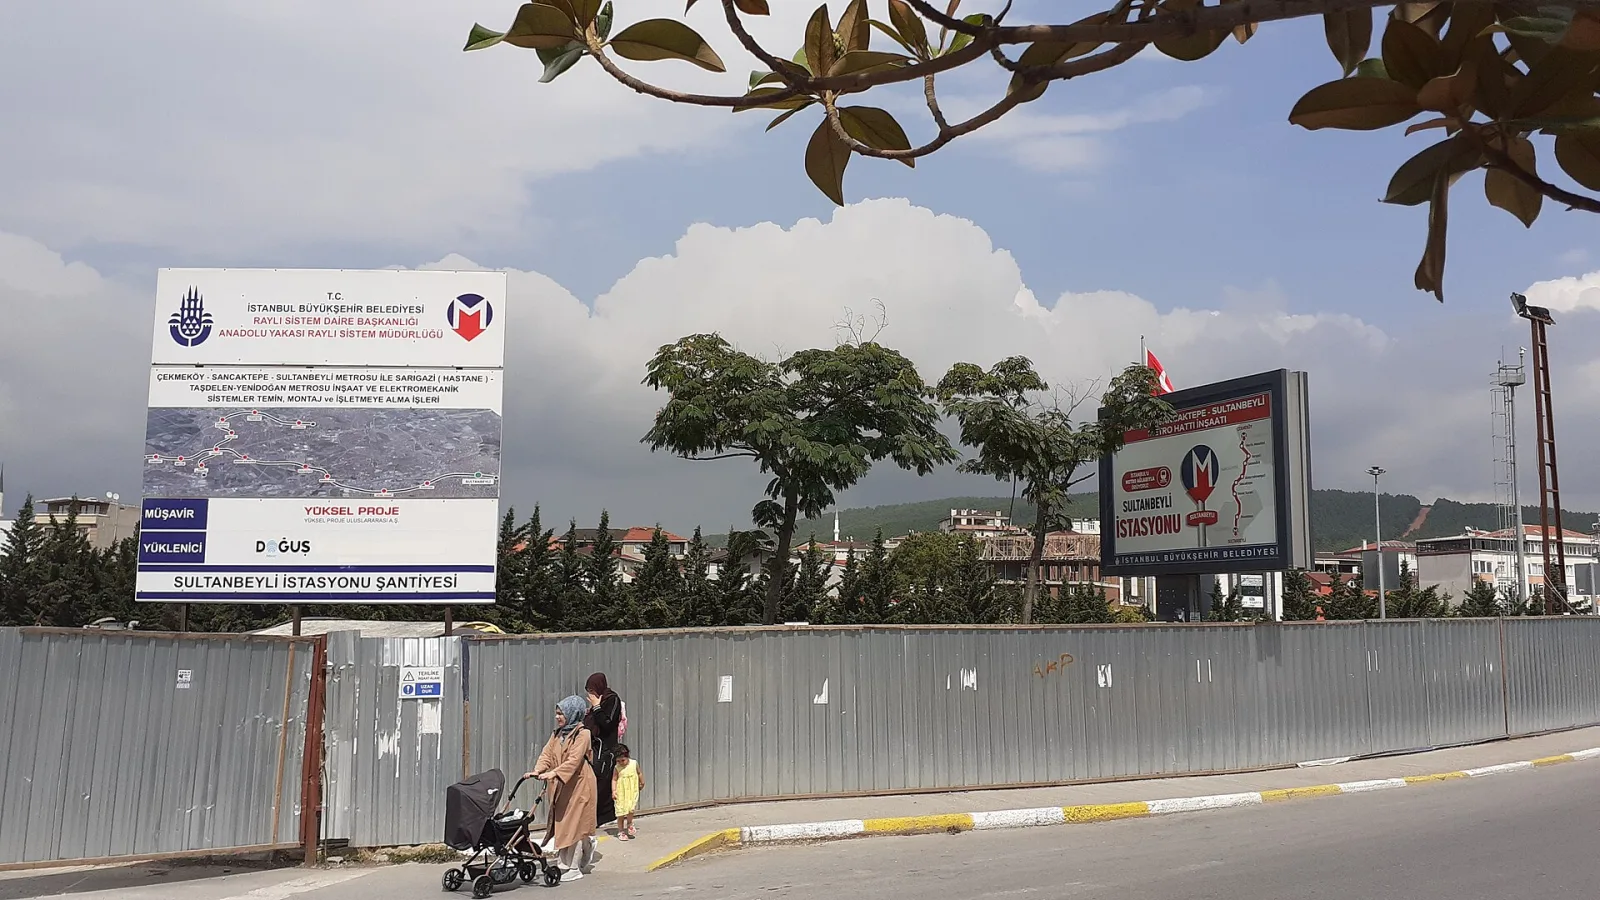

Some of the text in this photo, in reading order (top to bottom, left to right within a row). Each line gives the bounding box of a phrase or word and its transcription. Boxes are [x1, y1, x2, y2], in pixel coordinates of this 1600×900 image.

[327, 292, 344, 300] T.C.
[247, 302, 425, 315] İSTANBUL BÜYÜKŞEHİR BELEDİYESİ
[253, 315, 419, 328] RAYLI SİSTEM DAİRE BAŞKANLIĞI
[218, 328, 444, 339] ANADOLU YAKASI RAYLI SİSTEM MÜDÜRLÜĞÜ
[156, 373, 205, 382] ÇEKMEKÖY
[211, 373, 269, 381] SANCAKTEPE
[276, 373, 334, 382] SULTANBEYLİ
[335, 374, 378, 382] METROSU
[379, 373, 393, 382] İLE
[395, 373, 436, 382] SARIGAZİ
[190, 383, 286, 393] TAŞDELEN-YENİDOĞAN
[332, 384, 363, 394] İNŞAAT
[379, 384, 459, 393] ELEKTROMEKANİK
[207, 394, 255, 403] SİSTEMLER
[257, 394, 285, 404] TEMİN,
[287, 395, 322, 403] MONTAJ
[335, 395, 384, 404] İŞLETMEYE
[385, 396, 411, 404] ALMA
[412, 395, 440, 405] İŞLERİ
[1211, 395, 1265, 415] SULTANBEYLİ
[1174, 420, 1196, 432] HATTI
[1196, 414, 1227, 429] İNŞAATI
[1122, 492, 1172, 513] SULTANBEYLİ
[144, 507, 195, 521] MÜŞAVİR
[303, 506, 400, 516] YÜKSEL PROJE
[1116, 514, 1181, 539] İSTASYONU
[143, 541, 203, 553] YÜKLENİCİ
[1121, 546, 1279, 564] İSTANBUL BÜYÜKŞEHİR BELEDİYESİ
[174, 573, 458, 591] SULTANBEYLİ İSTASYONU ŞANTİYESİ
